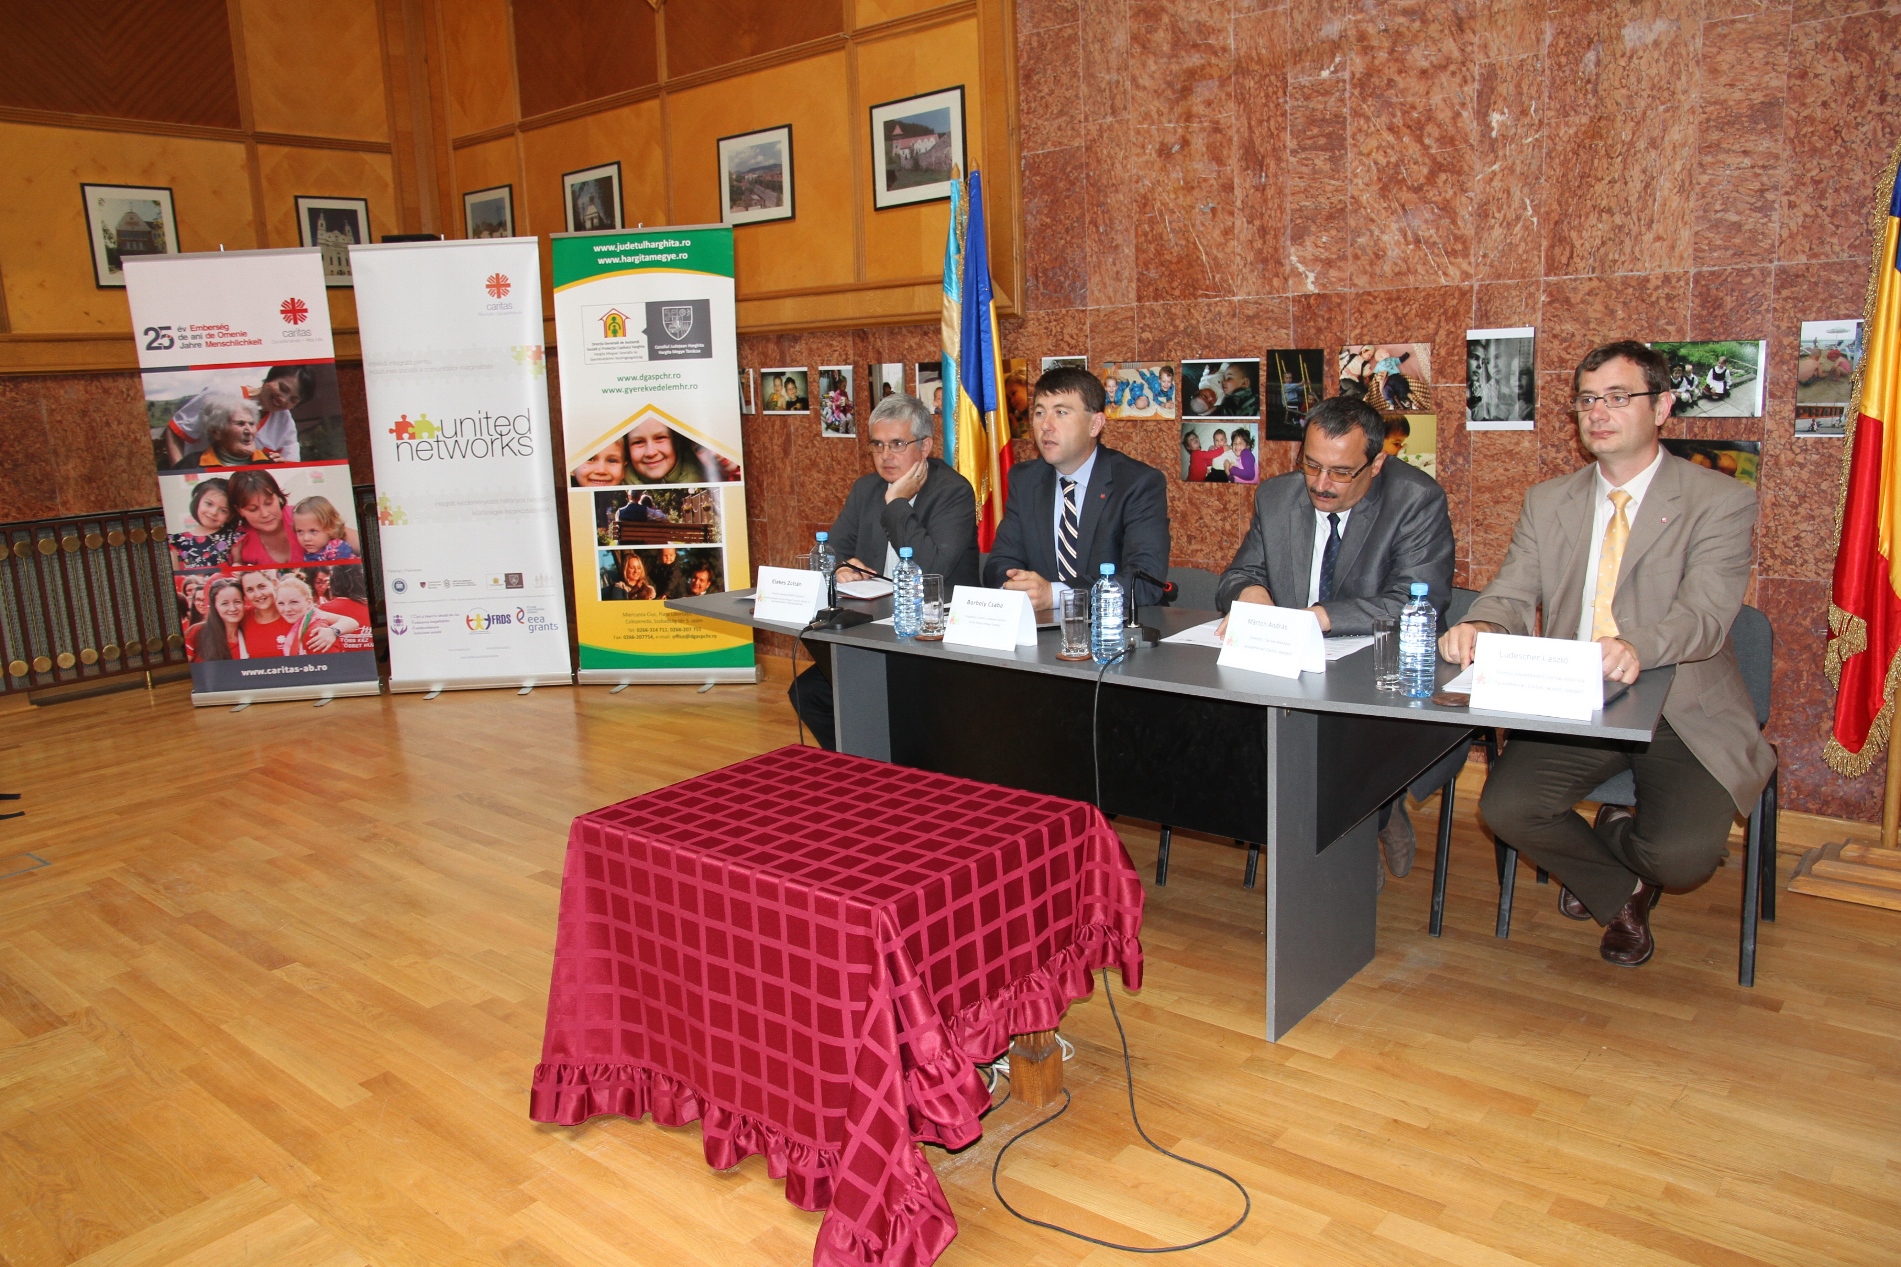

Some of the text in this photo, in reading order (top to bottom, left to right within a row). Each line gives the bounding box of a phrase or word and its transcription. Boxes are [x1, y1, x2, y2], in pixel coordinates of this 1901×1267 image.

[593, 239, 691, 252] www.judetulharghita.ro
[598, 252, 688, 264] www.hargitamegye.ro
[486, 301, 513, 311] caritas
[190, 323, 229, 334] Emberség
[283, 328, 312, 338] caritas
[143, 326, 175, 350] 25
[178, 333, 188, 341] de
[206, 331, 216, 339] de
[218, 330, 248, 338] Omenie
[179, 341, 202, 350] Jahre
[205, 338, 262, 348] Menschlichkeit
[617, 372, 681, 383] www.dgaspchr.ro
[602, 383, 698, 395] www.gyerekvedelemhr.ro
[440, 408, 532, 439] united
[395, 430, 534, 462] networks
[492, 614, 512, 624] FRDS
[528, 615, 545, 624] eea
[528, 622, 558, 633] grants
[241, 664, 328, 676] www.caritas-ab.ro
